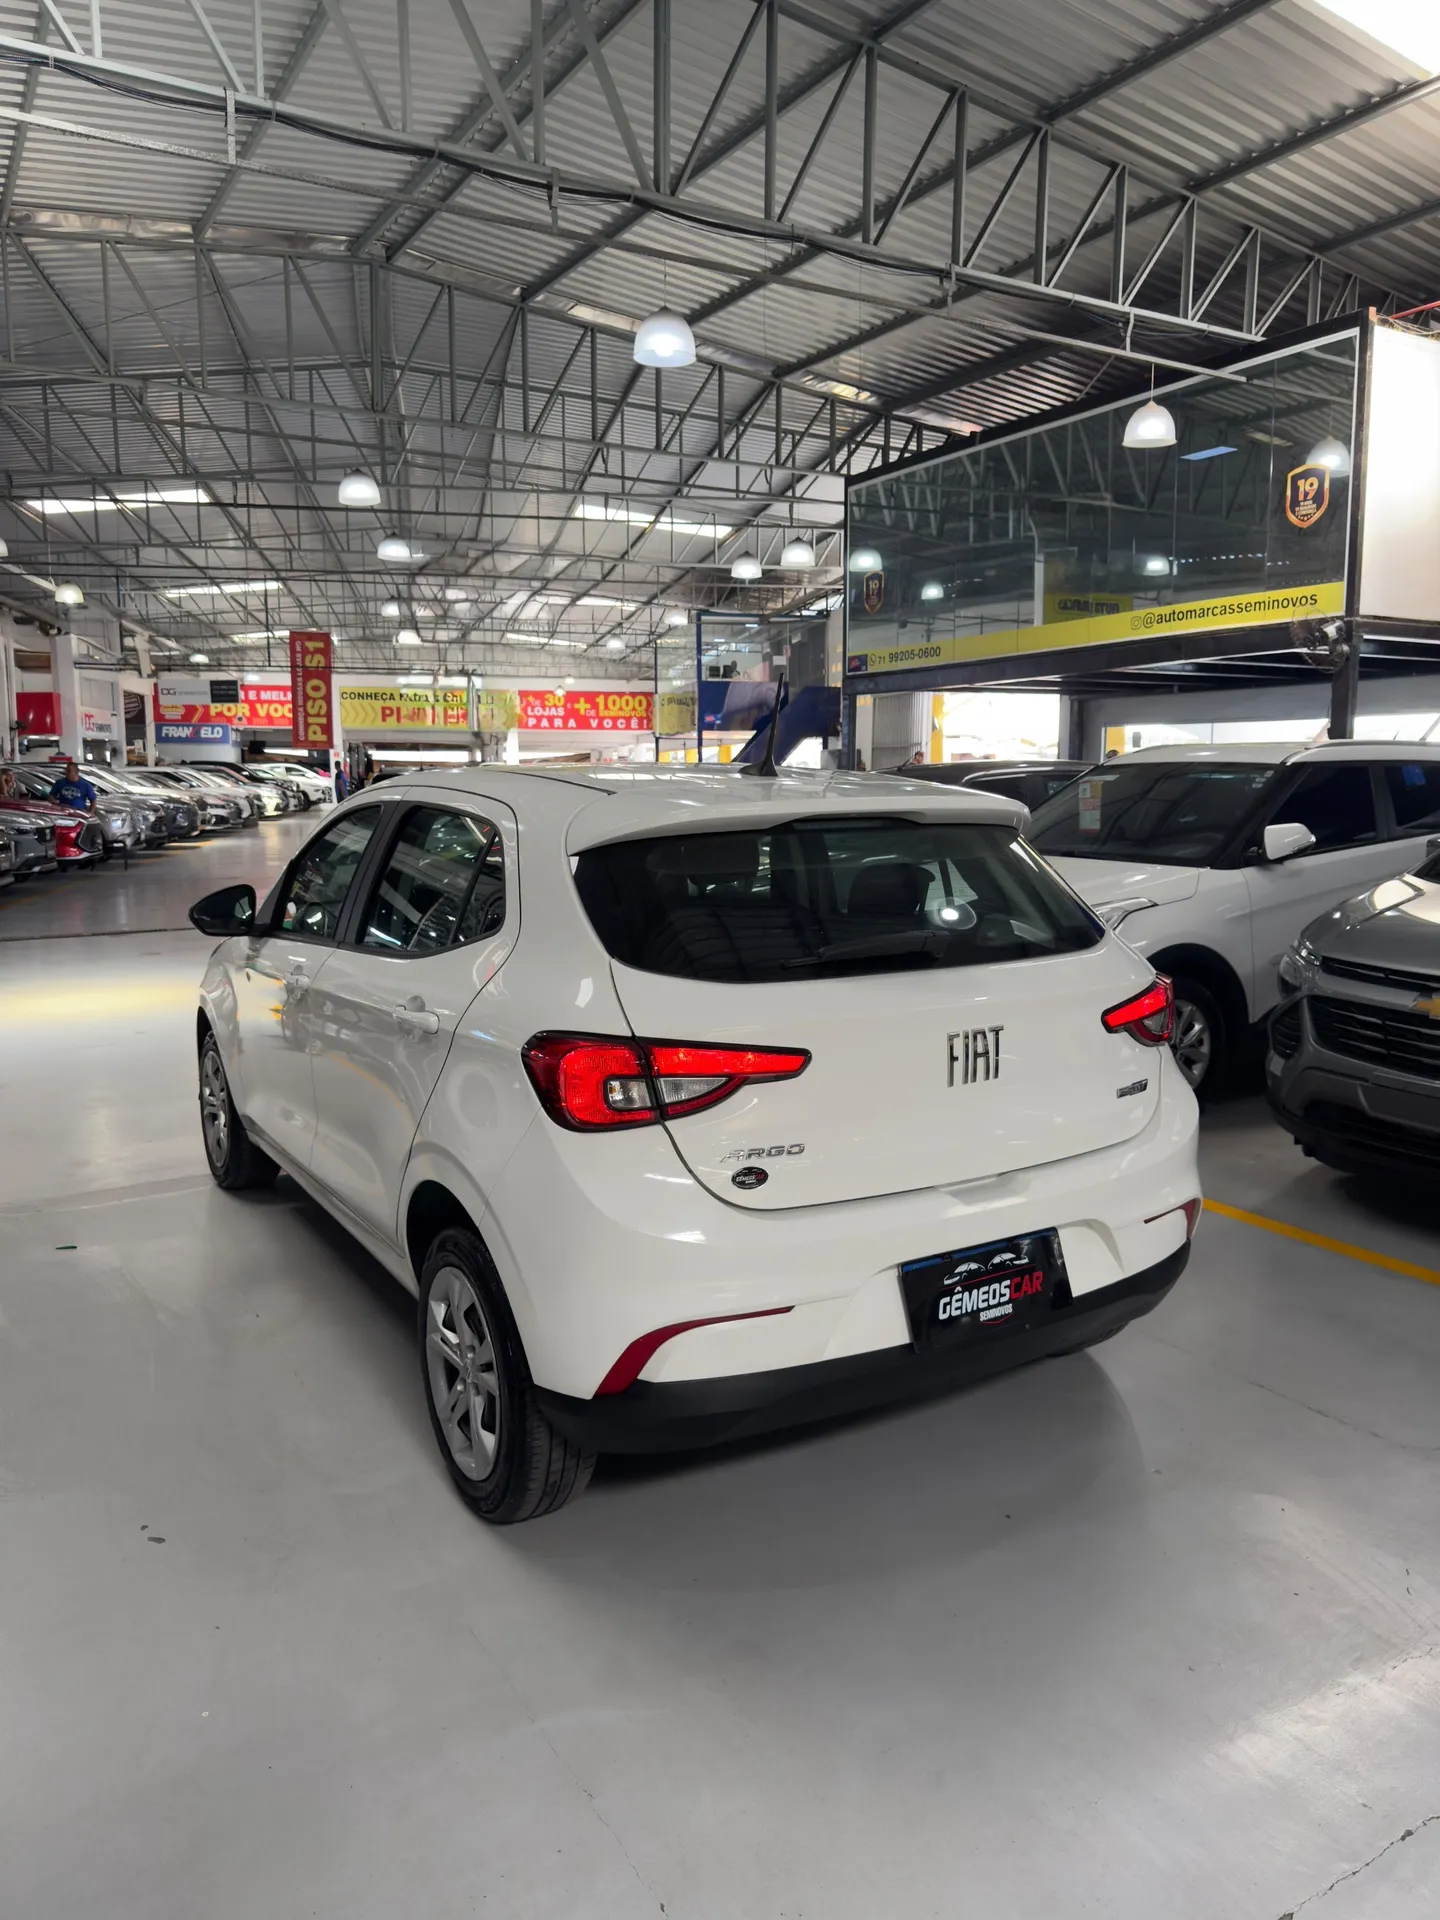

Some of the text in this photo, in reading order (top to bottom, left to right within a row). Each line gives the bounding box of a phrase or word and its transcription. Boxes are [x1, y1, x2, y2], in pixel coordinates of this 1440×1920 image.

[1297, 477, 1319, 501] 19
[1142, 593, 1318, 628] @automarcasseminovos
[878, 656, 886, 664] 71
[888, 646, 941, 663] 99205-0600
[304, 641, 328, 742] PISO S1
[341, 691, 396, 702] CONHEÇA
[545, 694, 564, 706] 30
[209, 703, 250, 716] POR
[527, 707, 565, 716] LOJAS
[596, 695, 647, 711] 1000
[528, 718, 577, 729] PARA
[946, 1024, 1004, 1087] FIAT
[719, 1143, 806, 1163] ARGO
[979, 1303, 1013, 1322] SEMINOVOS
